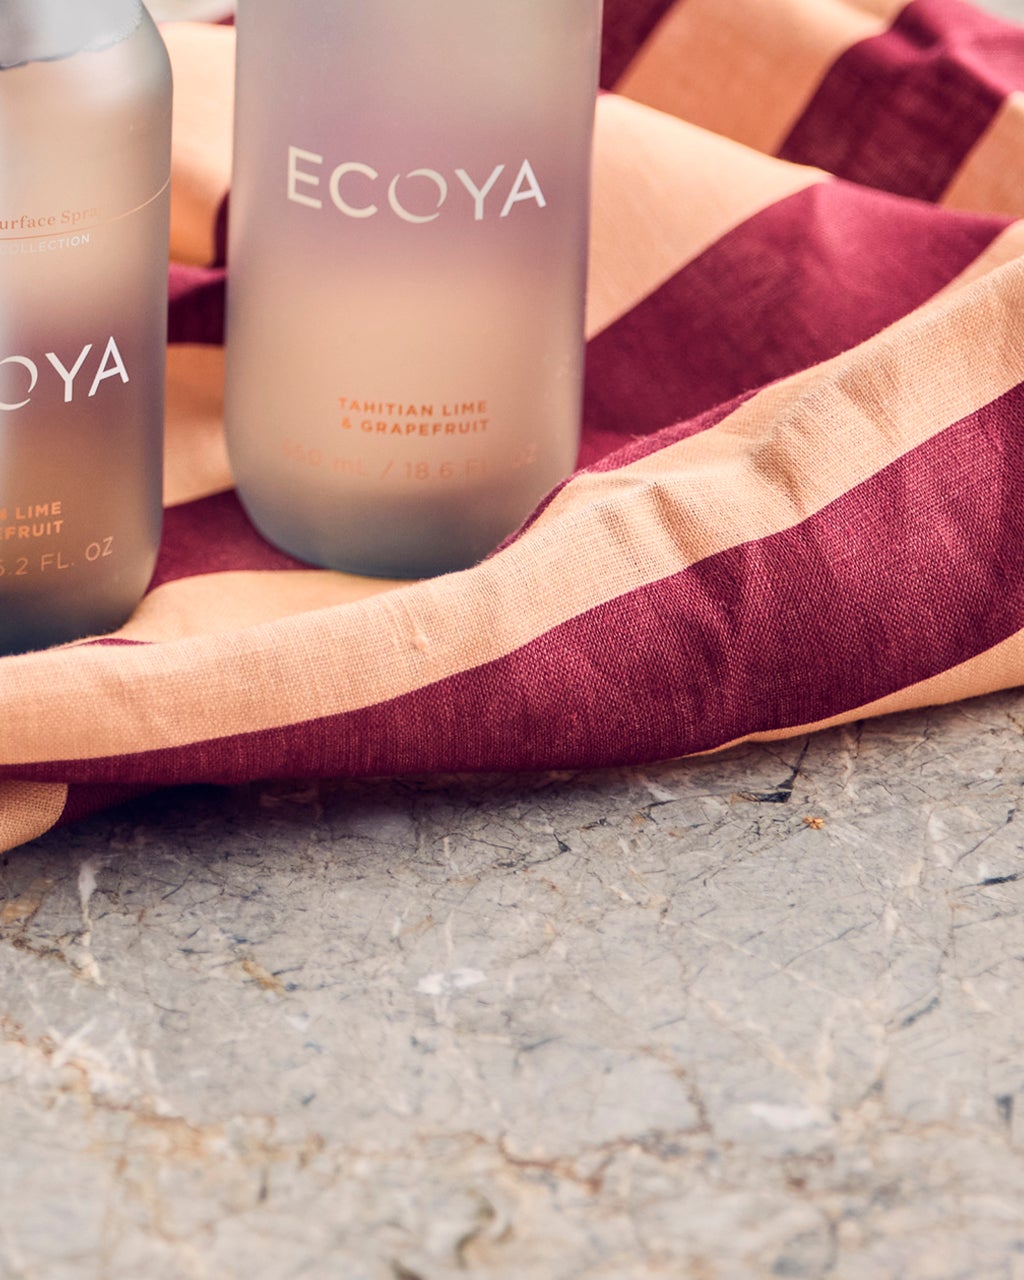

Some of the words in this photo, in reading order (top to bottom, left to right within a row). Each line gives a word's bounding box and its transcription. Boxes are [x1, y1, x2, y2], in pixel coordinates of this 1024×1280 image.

[287, 145, 547, 224] ECOYA
[60, 206, 102, 225] Spra
[0, 233, 90, 255] COLLECTION
[337, 396, 434, 417] TAHITIAN
[442, 399, 488, 417] LIME
[340, 417, 353, 430] &
[361, 419, 491, 437] GRAPEFRUIT
[404, 458, 454, 480] 186
[15, 500, 63, 520] LIME
[39, 552, 75, 573] FL.
[85, 535, 115, 562] OZ
